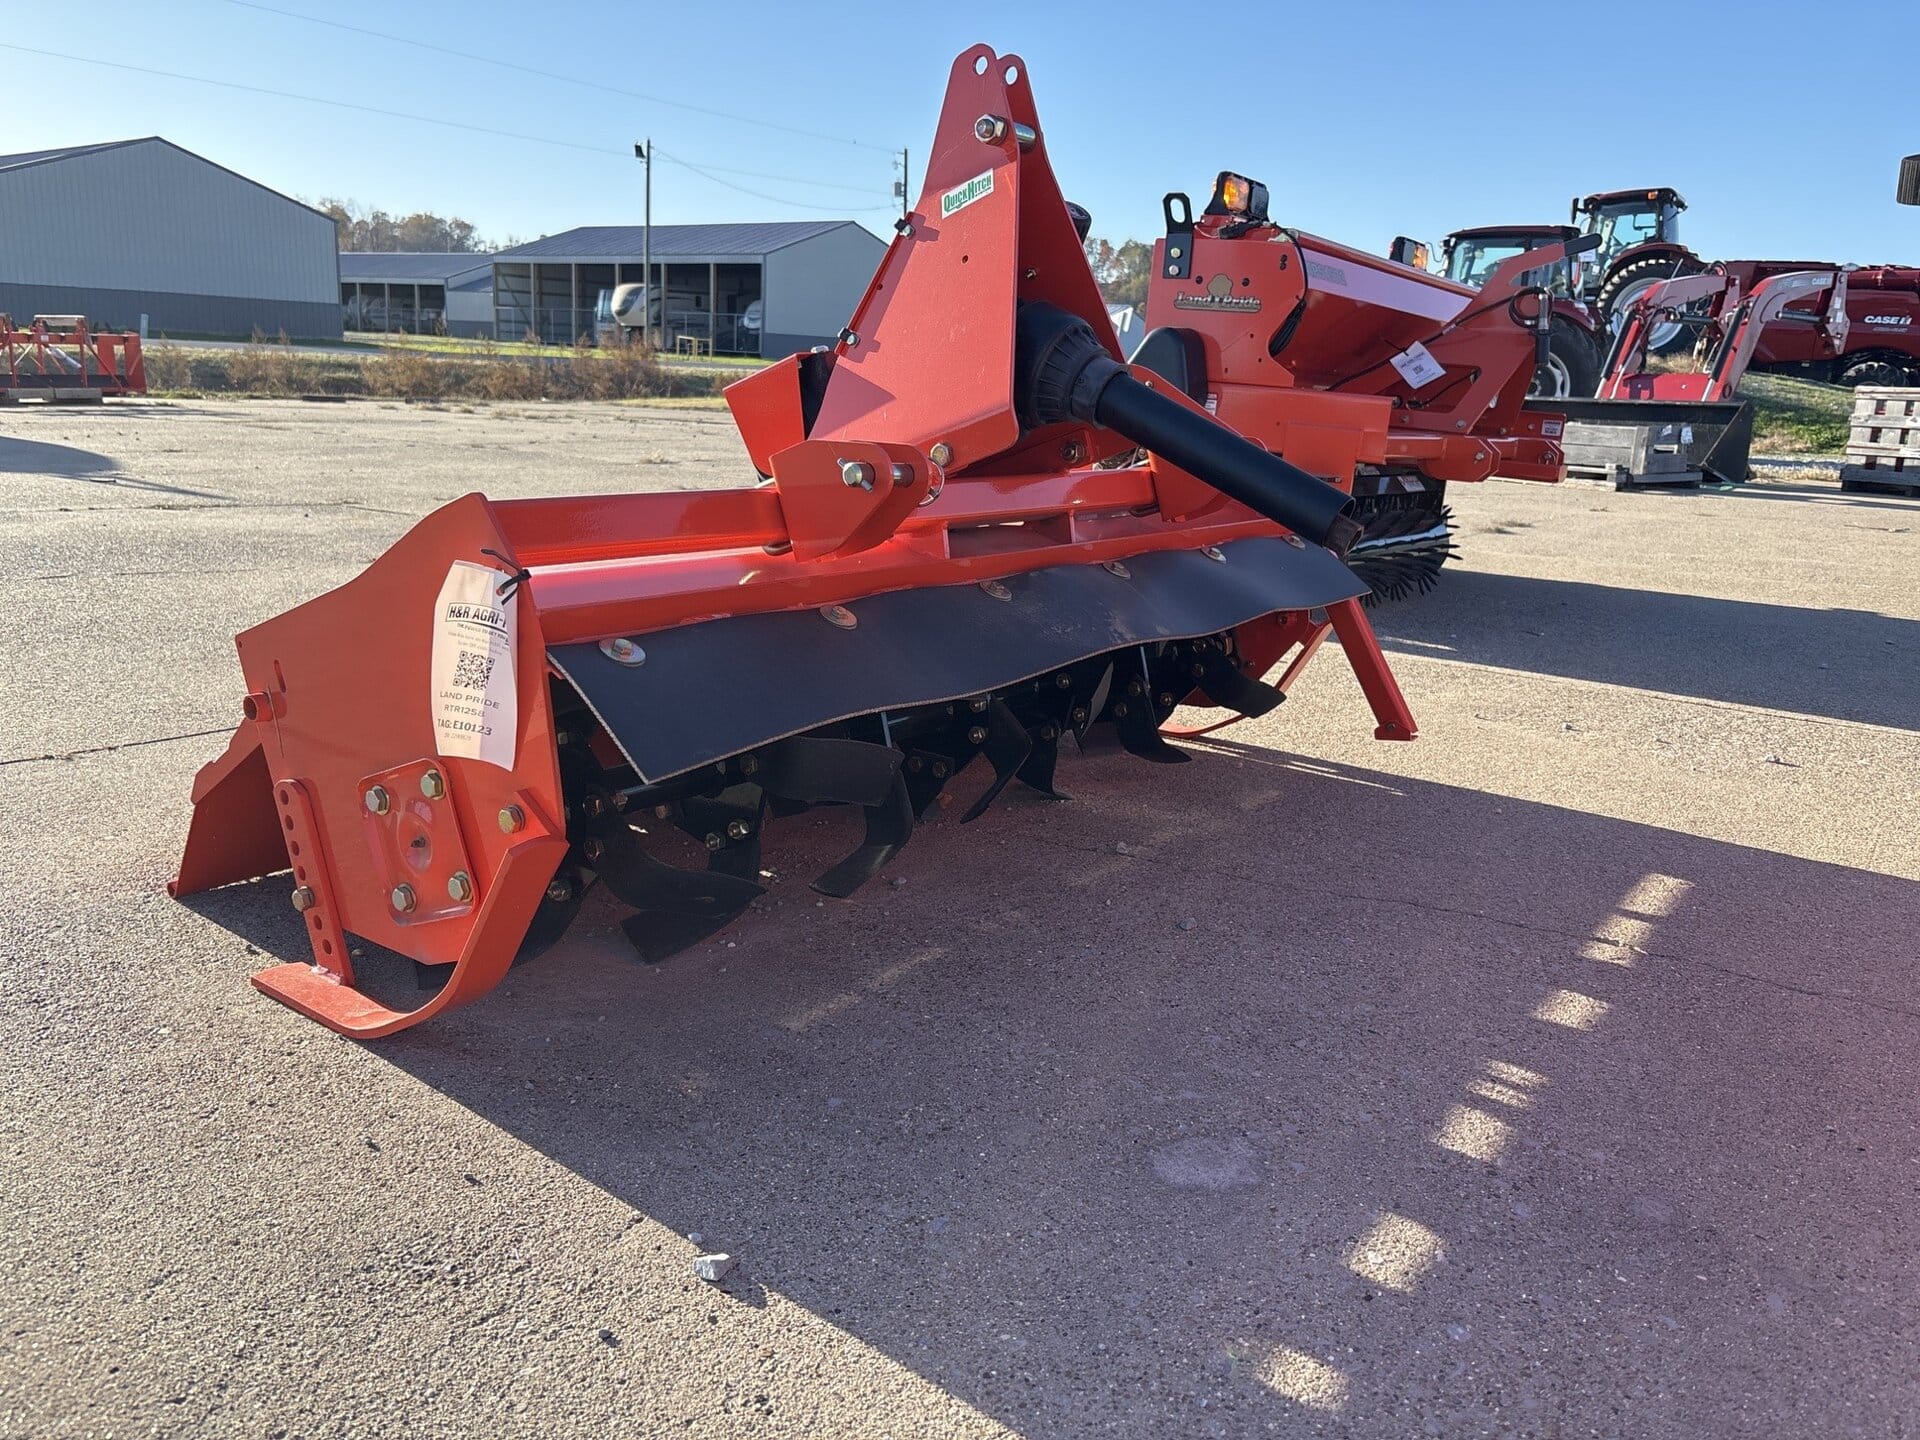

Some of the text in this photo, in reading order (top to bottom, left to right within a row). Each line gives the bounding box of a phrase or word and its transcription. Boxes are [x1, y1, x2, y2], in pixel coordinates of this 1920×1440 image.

[1864, 315, 1901, 324] CASE
[448, 605, 471, 618] H&R
[439, 691, 501, 709] LAND PRIDE
[444, 704, 485, 718] RTR1258
[453, 720, 493, 736] E10123
